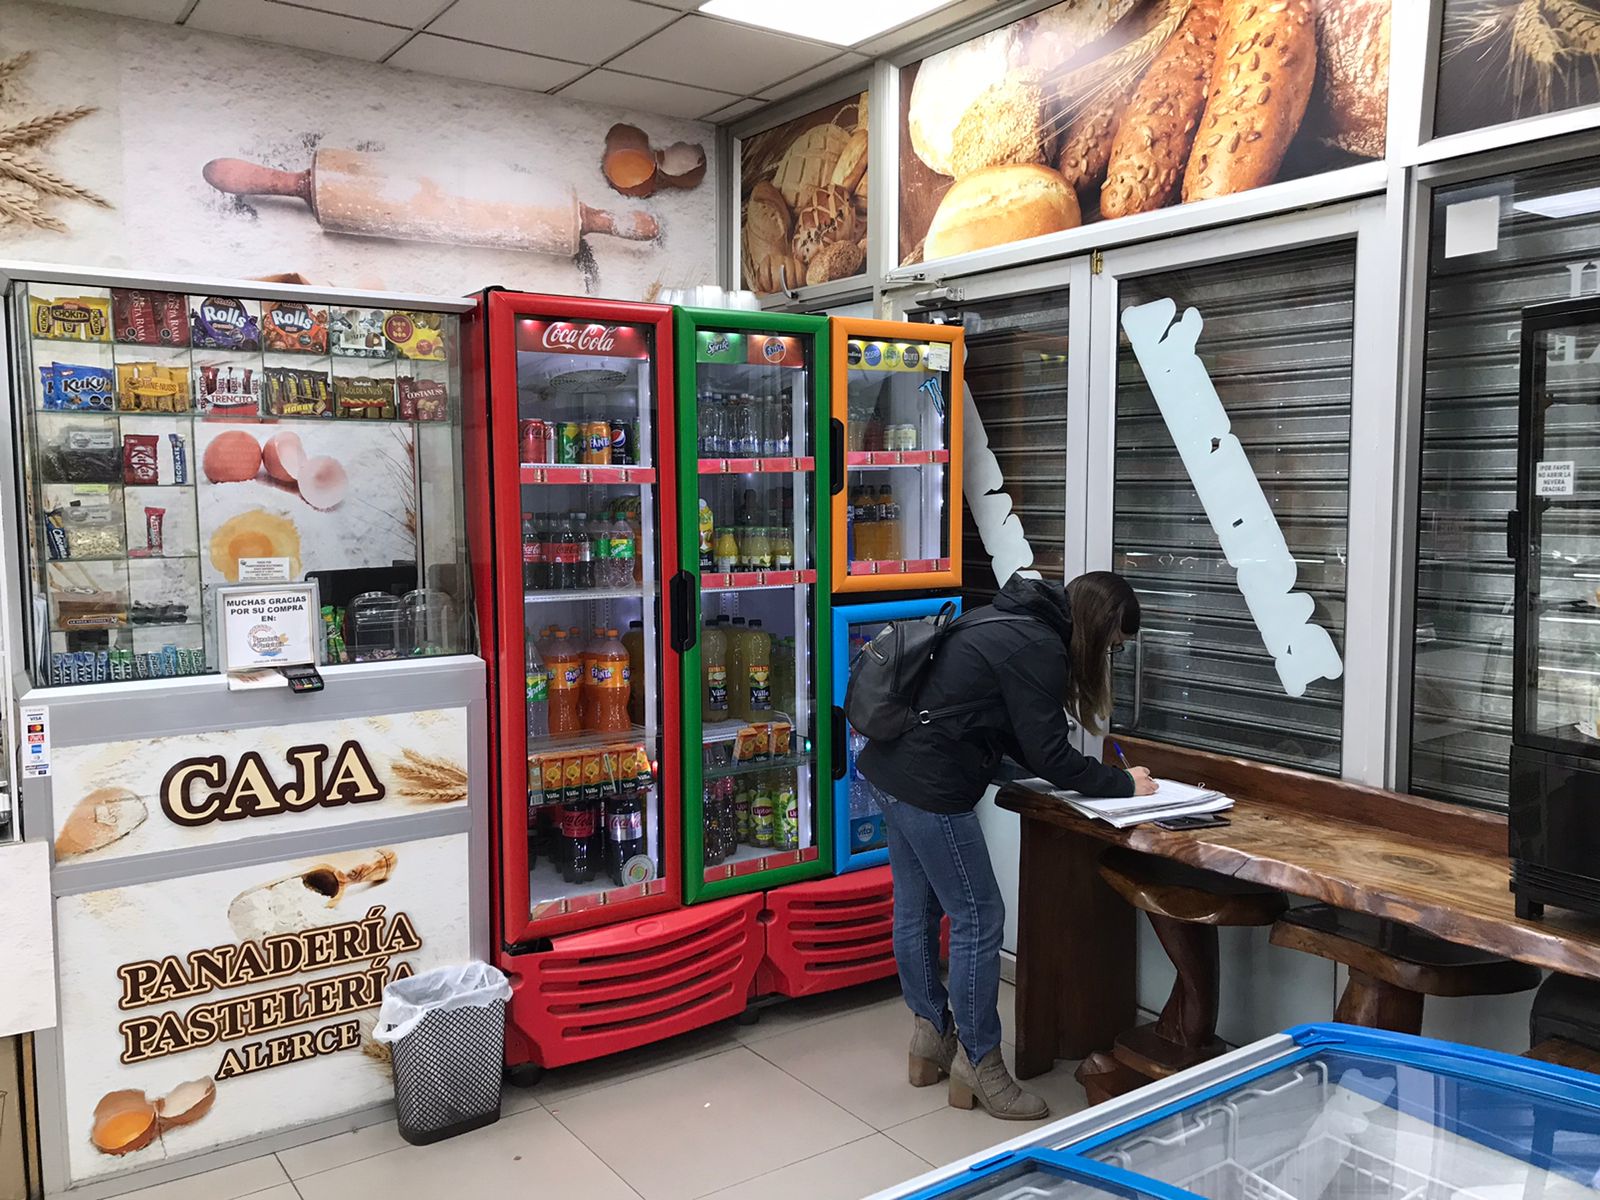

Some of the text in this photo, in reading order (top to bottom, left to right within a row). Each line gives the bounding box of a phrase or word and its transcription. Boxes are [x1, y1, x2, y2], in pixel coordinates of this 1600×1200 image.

[53, 309, 89, 320] CHOKITA
[203, 305, 247, 328] Rolls
[271, 310, 313, 330] Rolls
[542, 321, 617, 351] Coca-Cola
[706, 339, 729, 356] Sprite
[210, 394, 254, 404] TRENCITO
[283, 402, 314, 414] HOBBY
[226, 596, 307, 607] MUCHAS GRACIAS
[230, 607, 250, 615] POR
[267, 605, 304, 613] COMPRA
[160, 740, 385, 827] CAJA
[117, 905, 421, 1010] PANADERÍA
[215, 1020, 361, 1081] ALERCE
